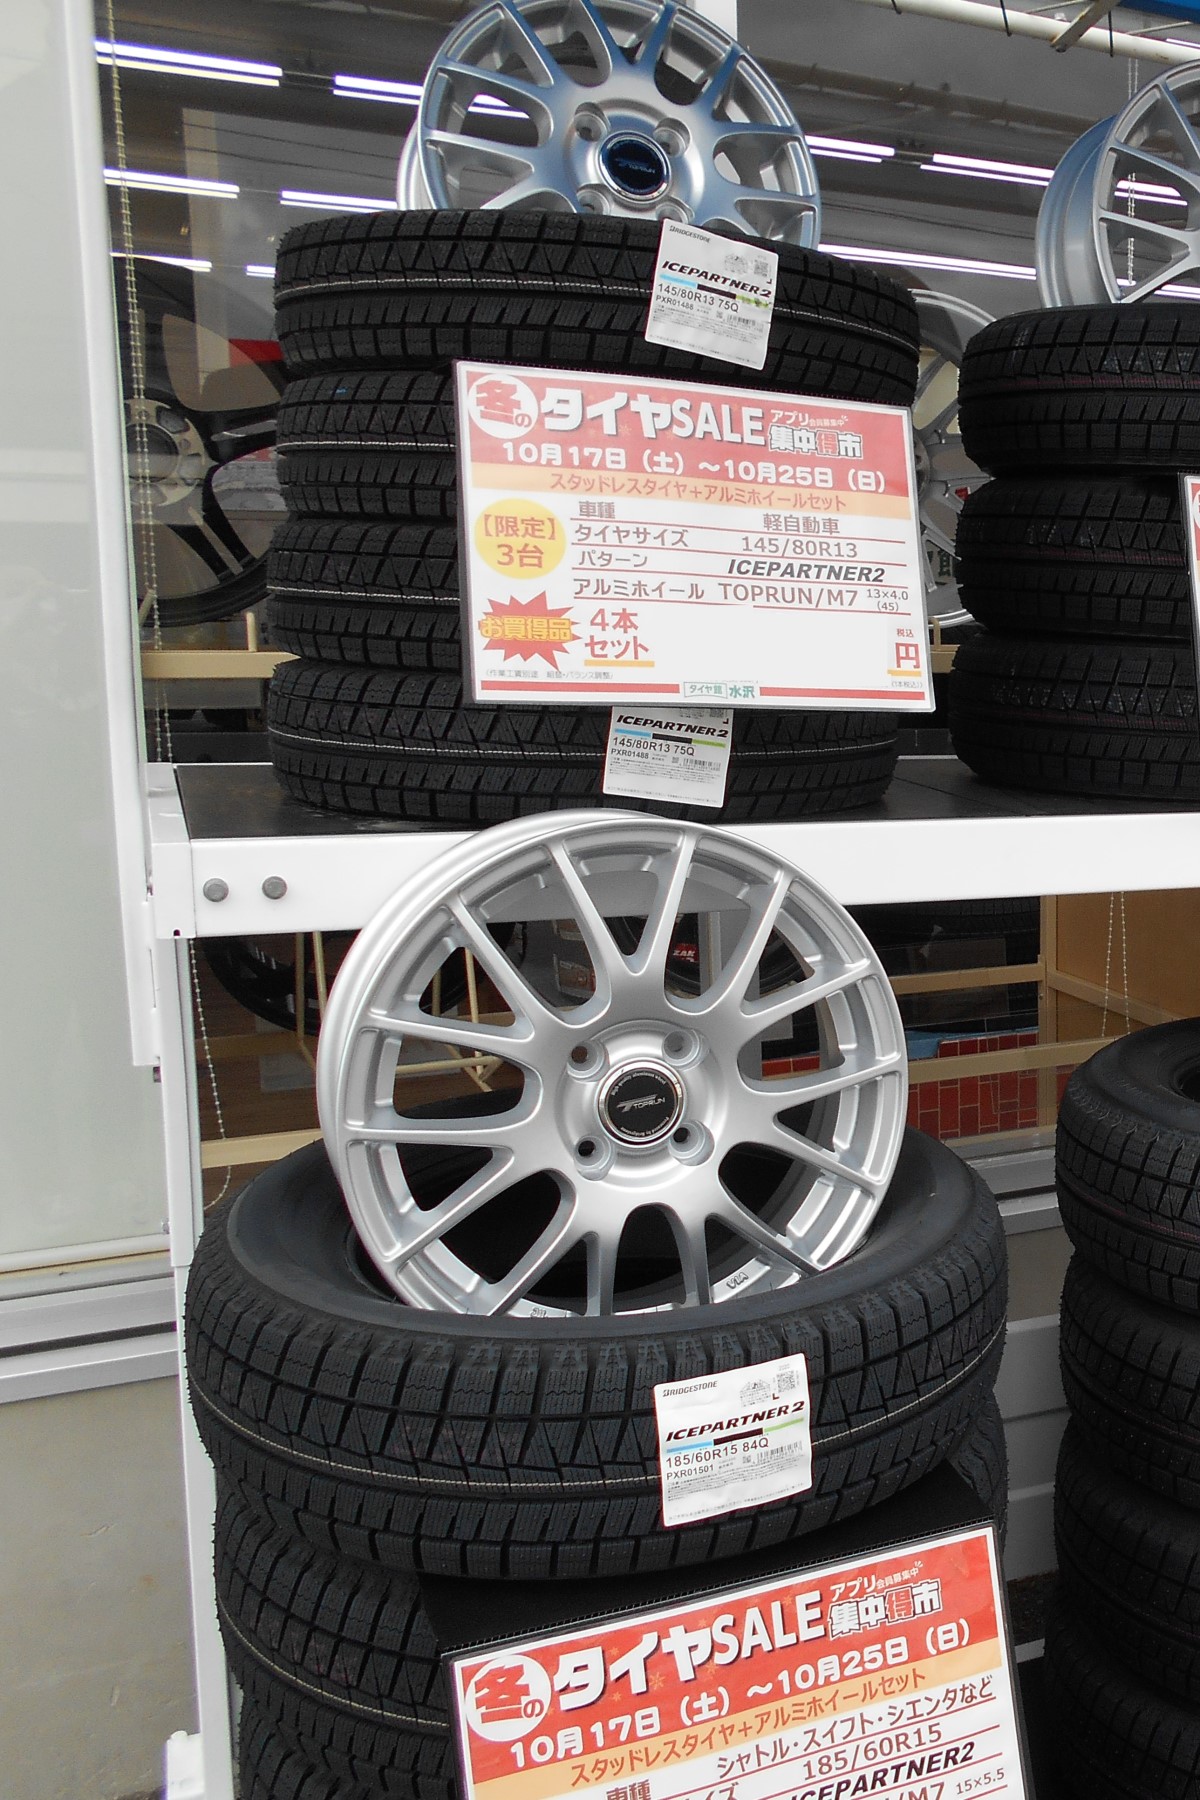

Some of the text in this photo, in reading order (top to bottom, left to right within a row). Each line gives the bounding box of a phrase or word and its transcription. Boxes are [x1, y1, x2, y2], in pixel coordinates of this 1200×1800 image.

[656, 295, 694, 310] PXR01488
[658, 284, 739, 313] 145/80R13 75Q
[578, 501, 840, 535] 車種 軽自動車
[495, 543, 545, 569] 3台
[574, 526, 858, 558] タイヤサイズ 145/80R13
[578, 550, 886, 583] パターン ICEPARTNER2
[572, 577, 705, 601] アルミホイール
[717, 583, 859, 607] TOPRUN/M7
[479, 615, 575, 642] お買得品
[588, 608, 639, 633] 4本
[585, 634, 921, 670] セット 円
[729, 684, 756, 699] 水沢
[611, 748, 649, 759] PXR01488
[613, 737, 695, 756] 145/80R13 75Q
[663, 1380, 718, 1397] BRIDGESTONE
[666, 1437, 769, 1468] 185/60R15 84Q
[667, 1465, 714, 1480] PXR01501
[827, 1581, 943, 1641] 集中得市
[716, 1674, 996, 1782] シャトル・スイフト・シエンタなど
[802, 1723, 943, 1781] 185/60R15
[955, 1766, 1006, 1797] 15×5.5
